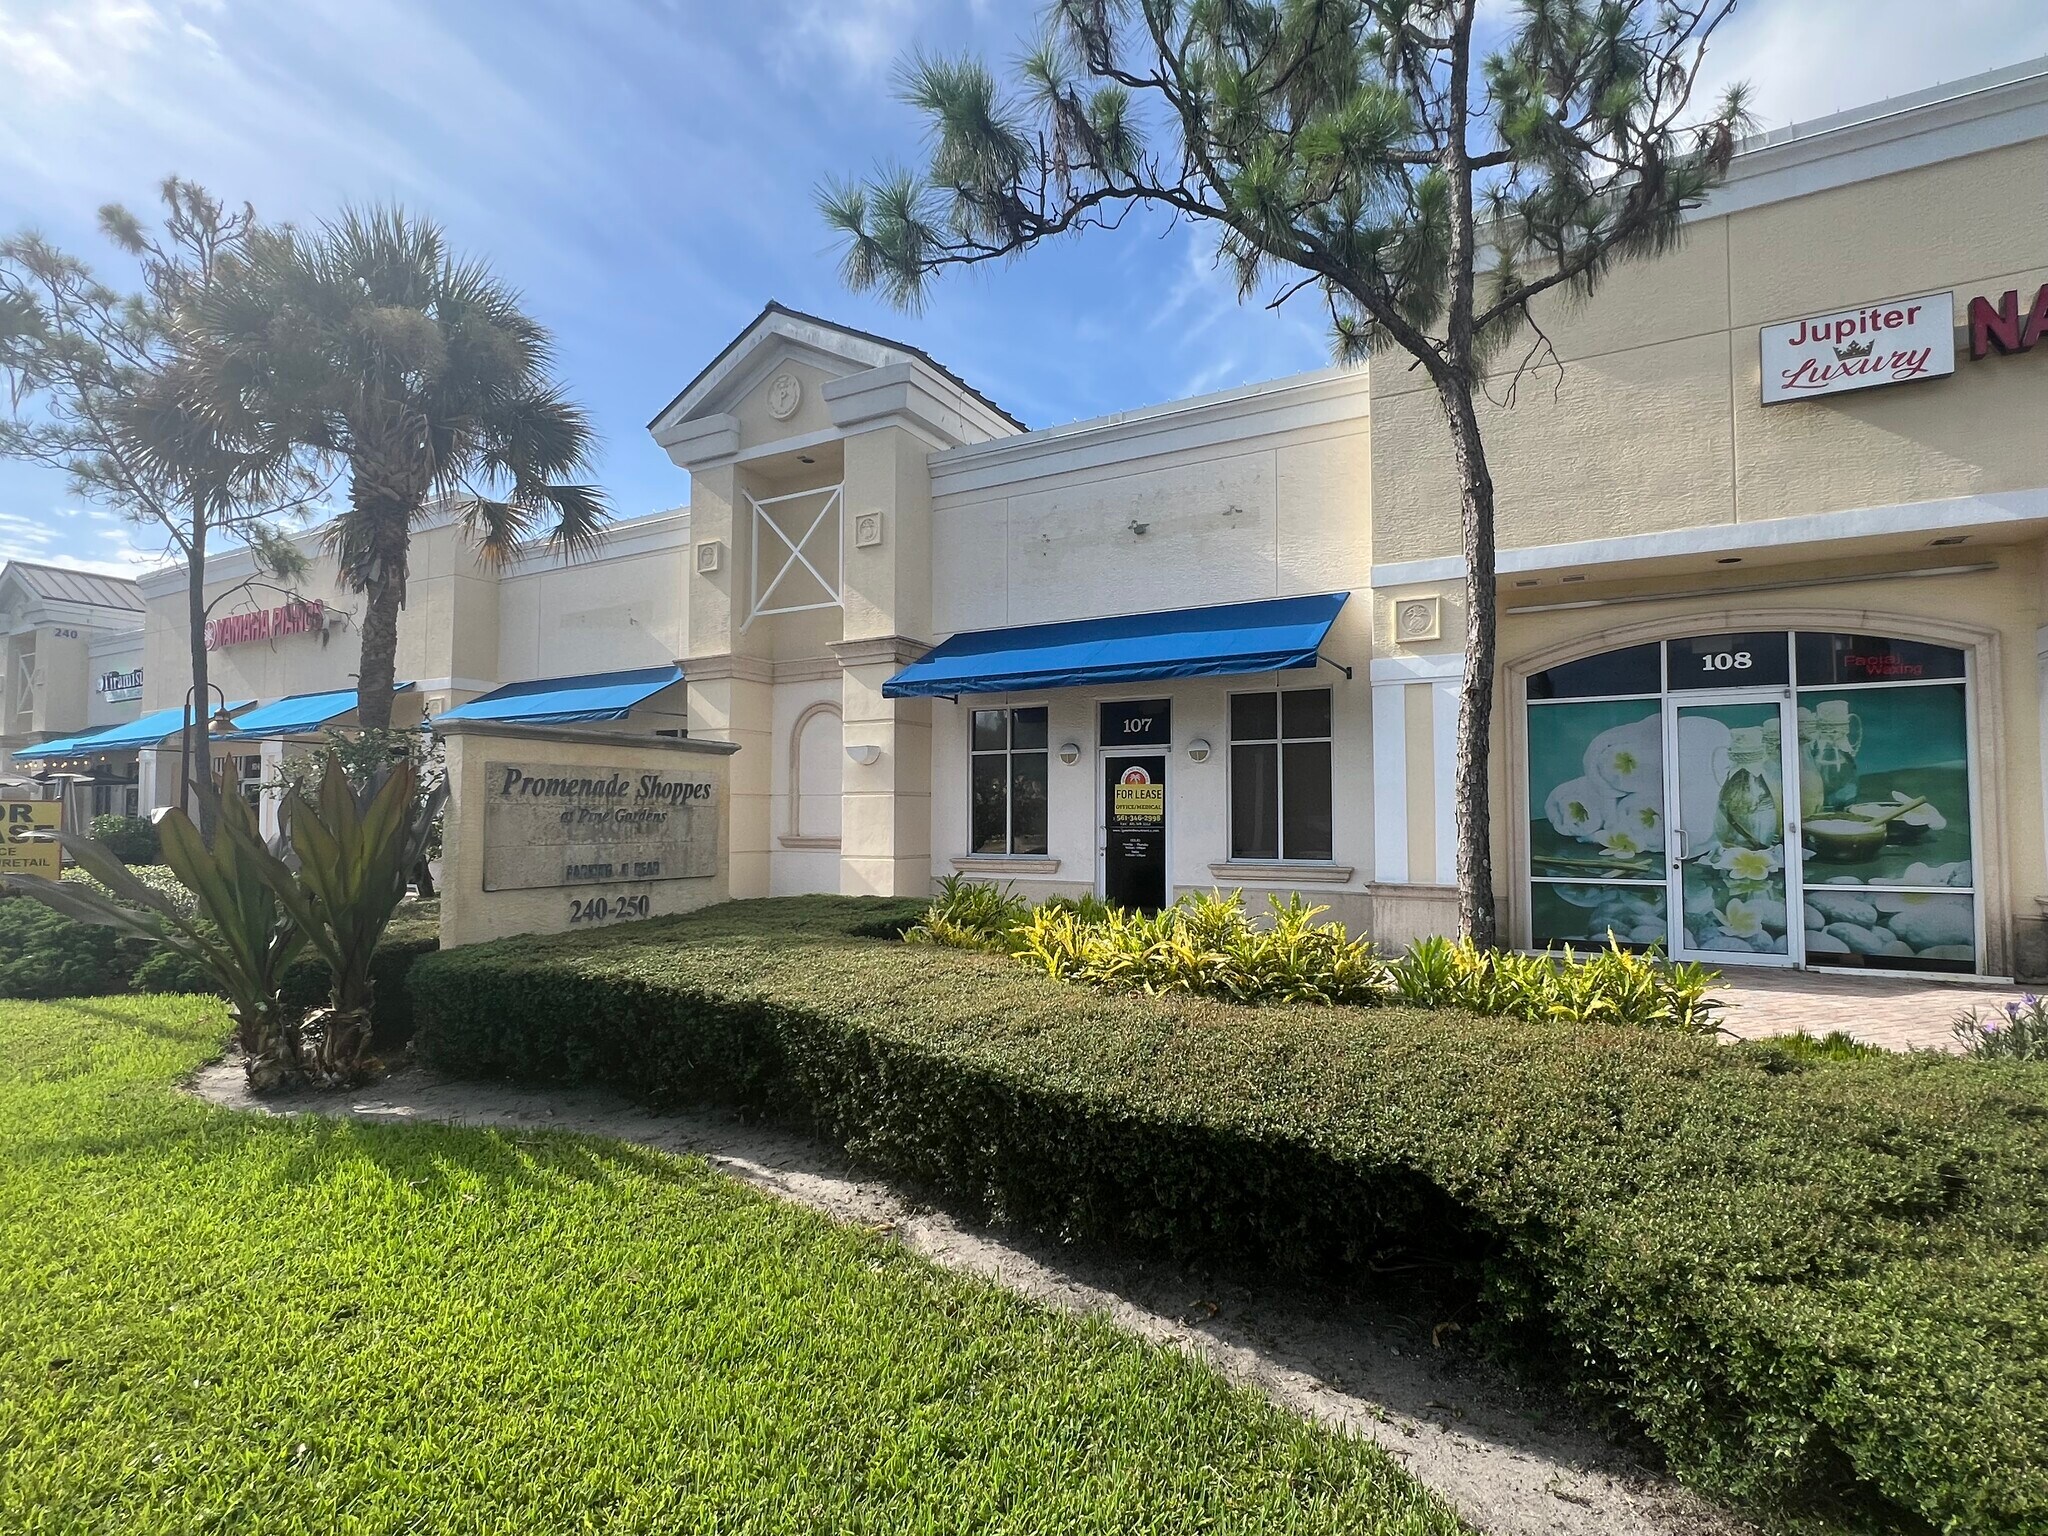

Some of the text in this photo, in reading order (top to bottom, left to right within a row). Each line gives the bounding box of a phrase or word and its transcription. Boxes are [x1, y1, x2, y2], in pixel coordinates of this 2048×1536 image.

[1788, 305, 1922, 346] Jupiter
[1968, 283, 2048, 361] NA
[1781, 347, 1932, 389] Luxury
[54, 627, 78, 639] 240
[217, 609, 270, 646] YAMAHA
[1702, 651, 1753, 671] 108
[1123, 718, 1153, 733] 107
[501, 768, 711, 804] Promenade Shoppes
[1116, 789, 1162, 799] FOR LEASE
[614, 808, 668, 823] Gardens
[569, 895, 650, 923] 240-250
